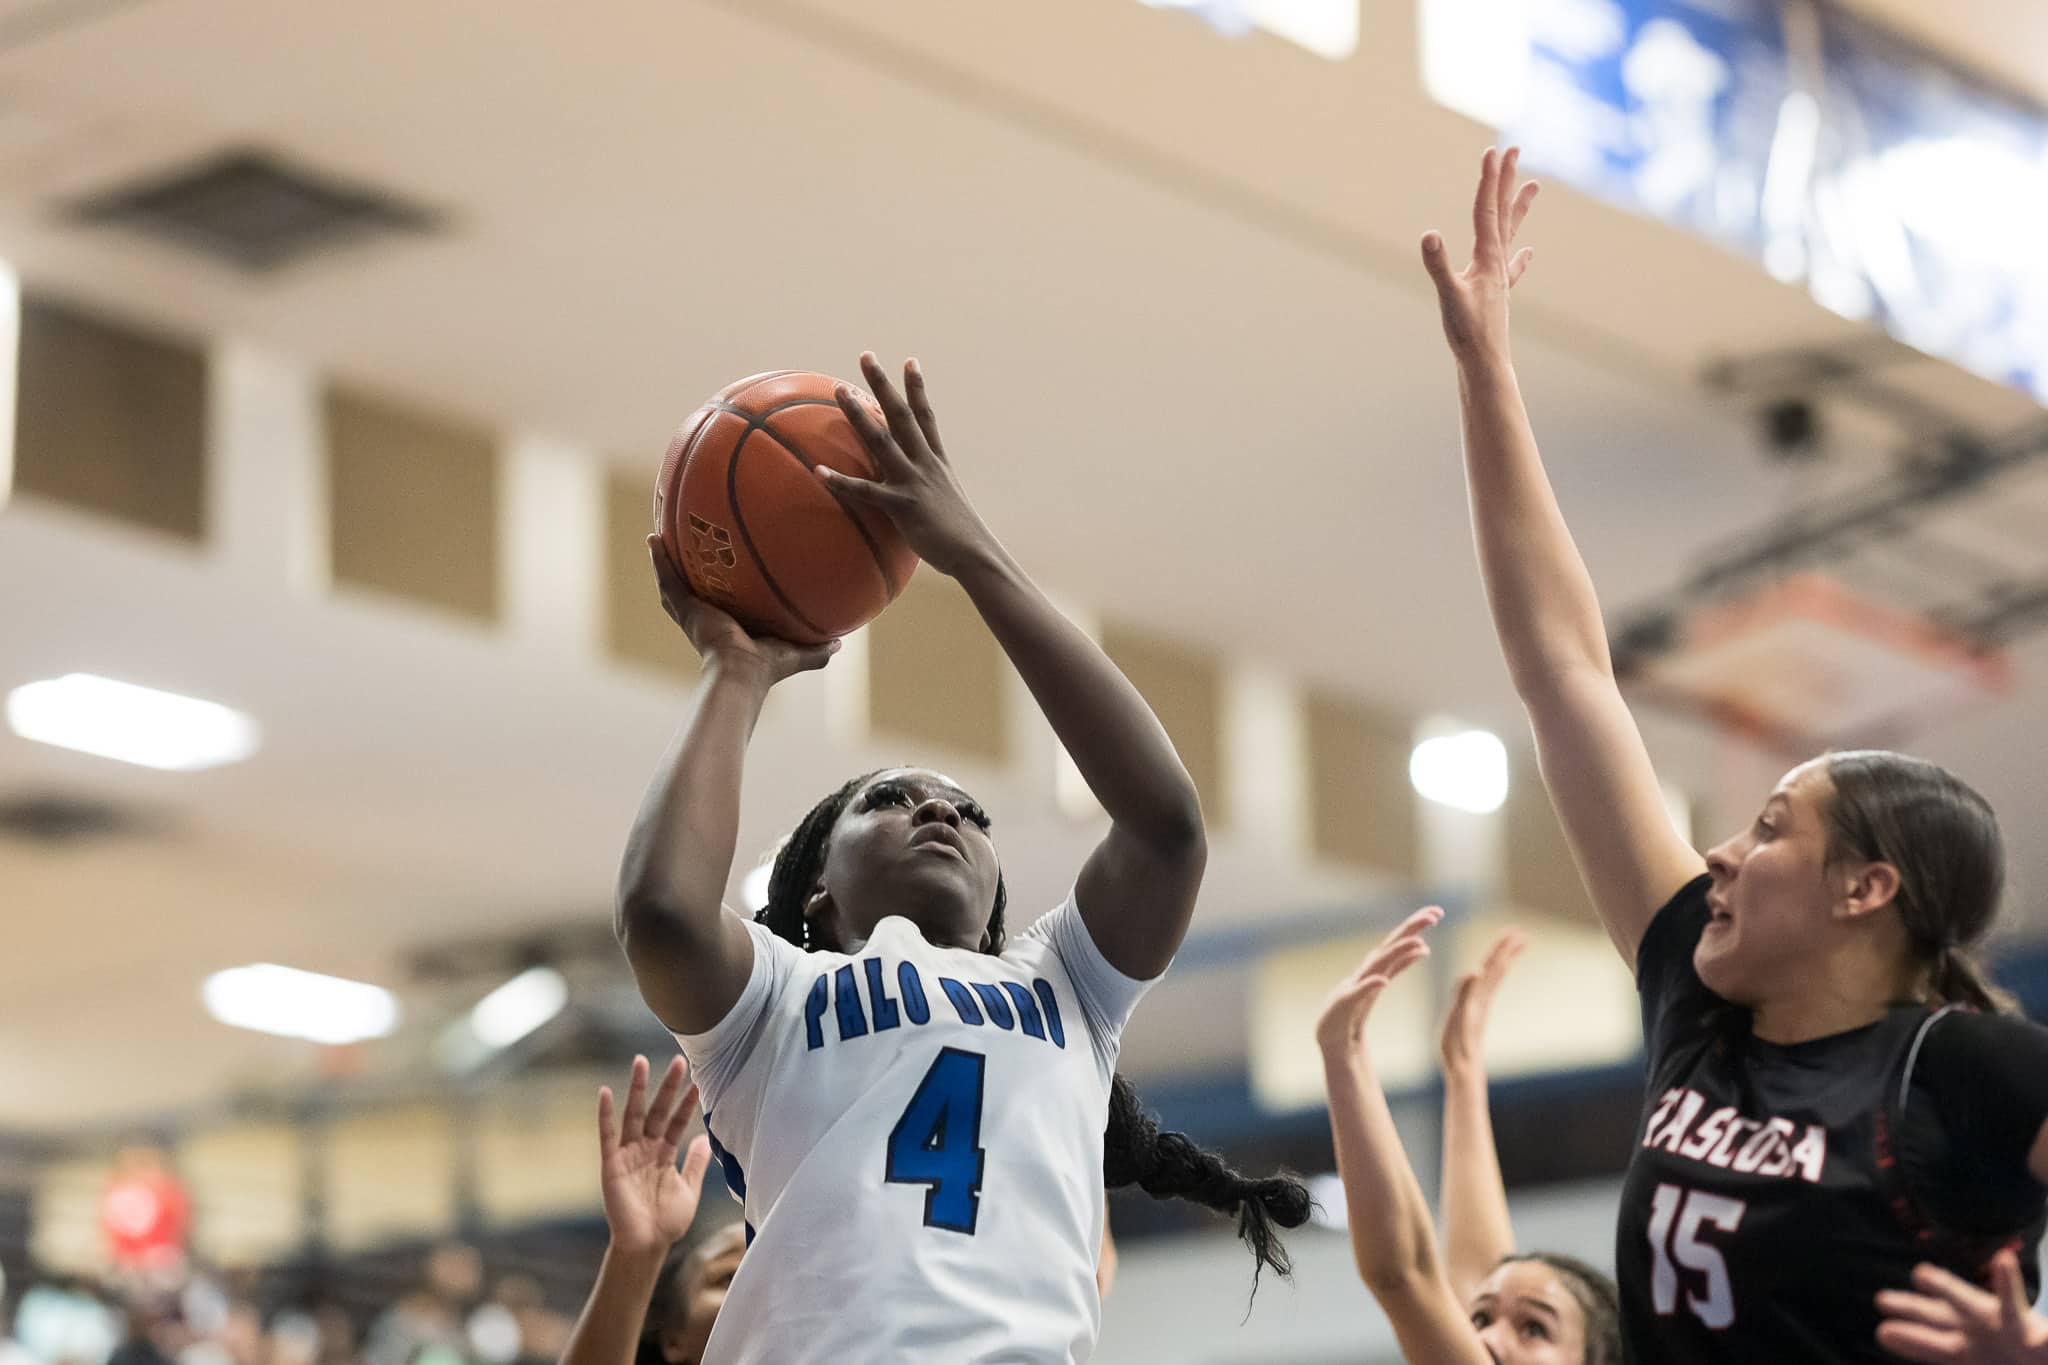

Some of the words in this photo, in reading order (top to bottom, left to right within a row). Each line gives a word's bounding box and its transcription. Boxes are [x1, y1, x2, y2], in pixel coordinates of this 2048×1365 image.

[805, 957, 931, 1051] PALO
[938, 977, 1066, 1050] DURO
[884, 1045, 987, 1236] 4
[1642, 1087, 1827, 1184] TASCOSA
[1647, 1182, 1747, 1331] 15
